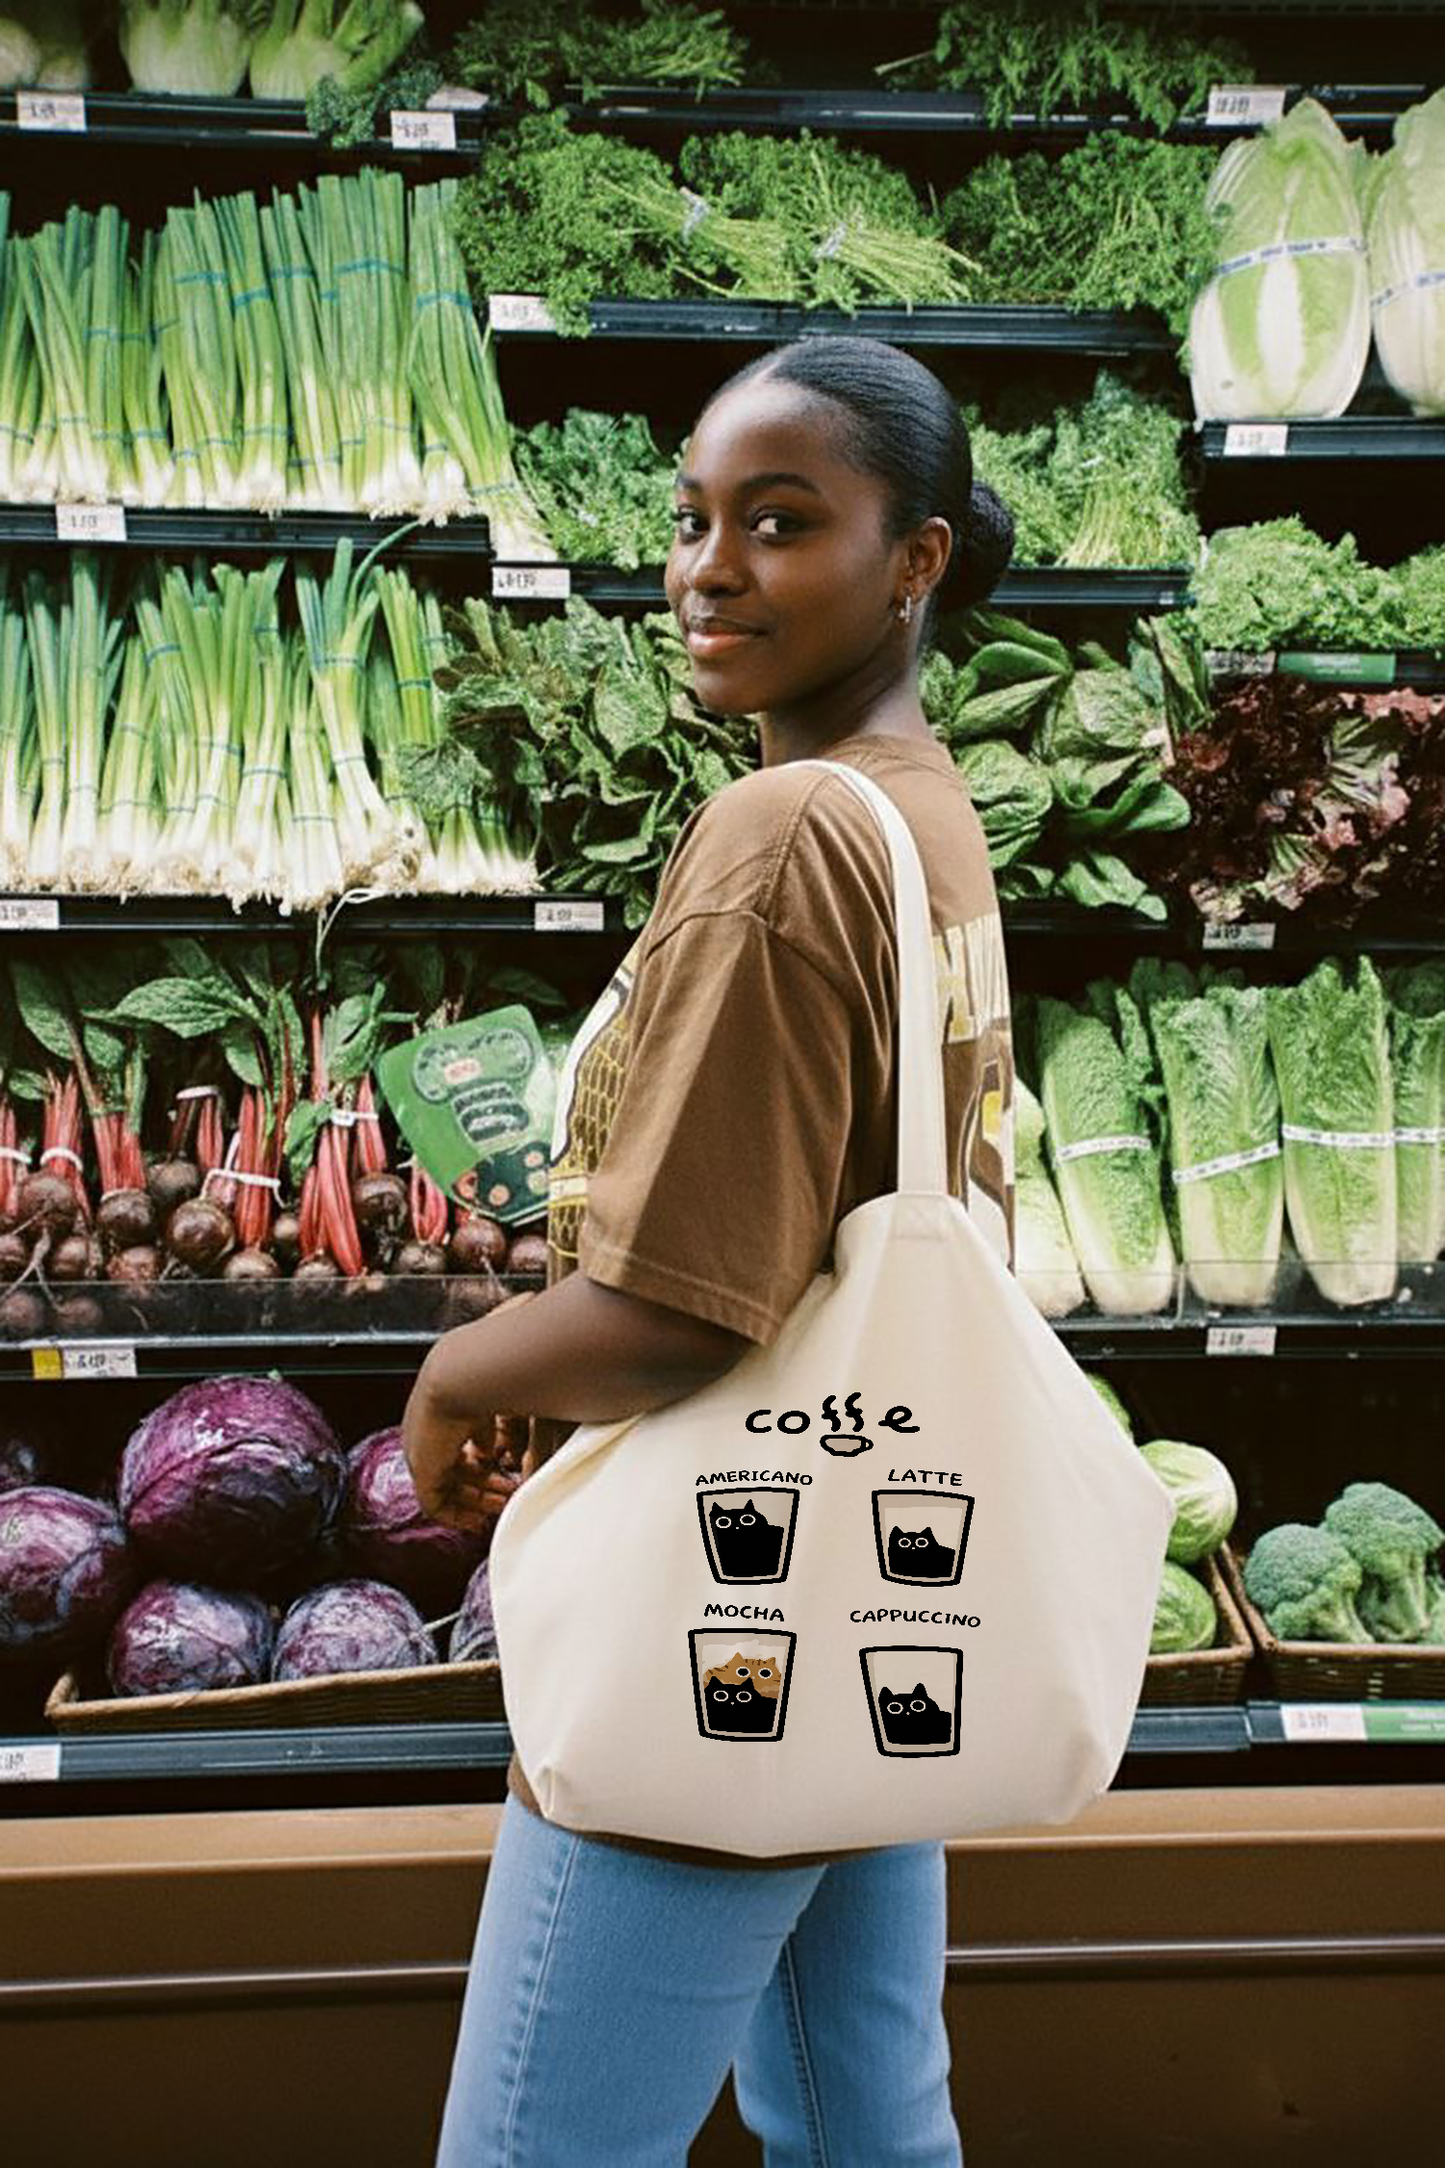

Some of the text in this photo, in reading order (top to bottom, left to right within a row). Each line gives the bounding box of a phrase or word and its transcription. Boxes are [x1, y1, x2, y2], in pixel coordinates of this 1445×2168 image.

[695, 1469, 813, 1487] AMERICANO
[887, 1468, 963, 1487] LATTE
[703, 1603, 785, 1622] MOCHA
[849, 1608, 981, 1628] CAPPUCCINO
